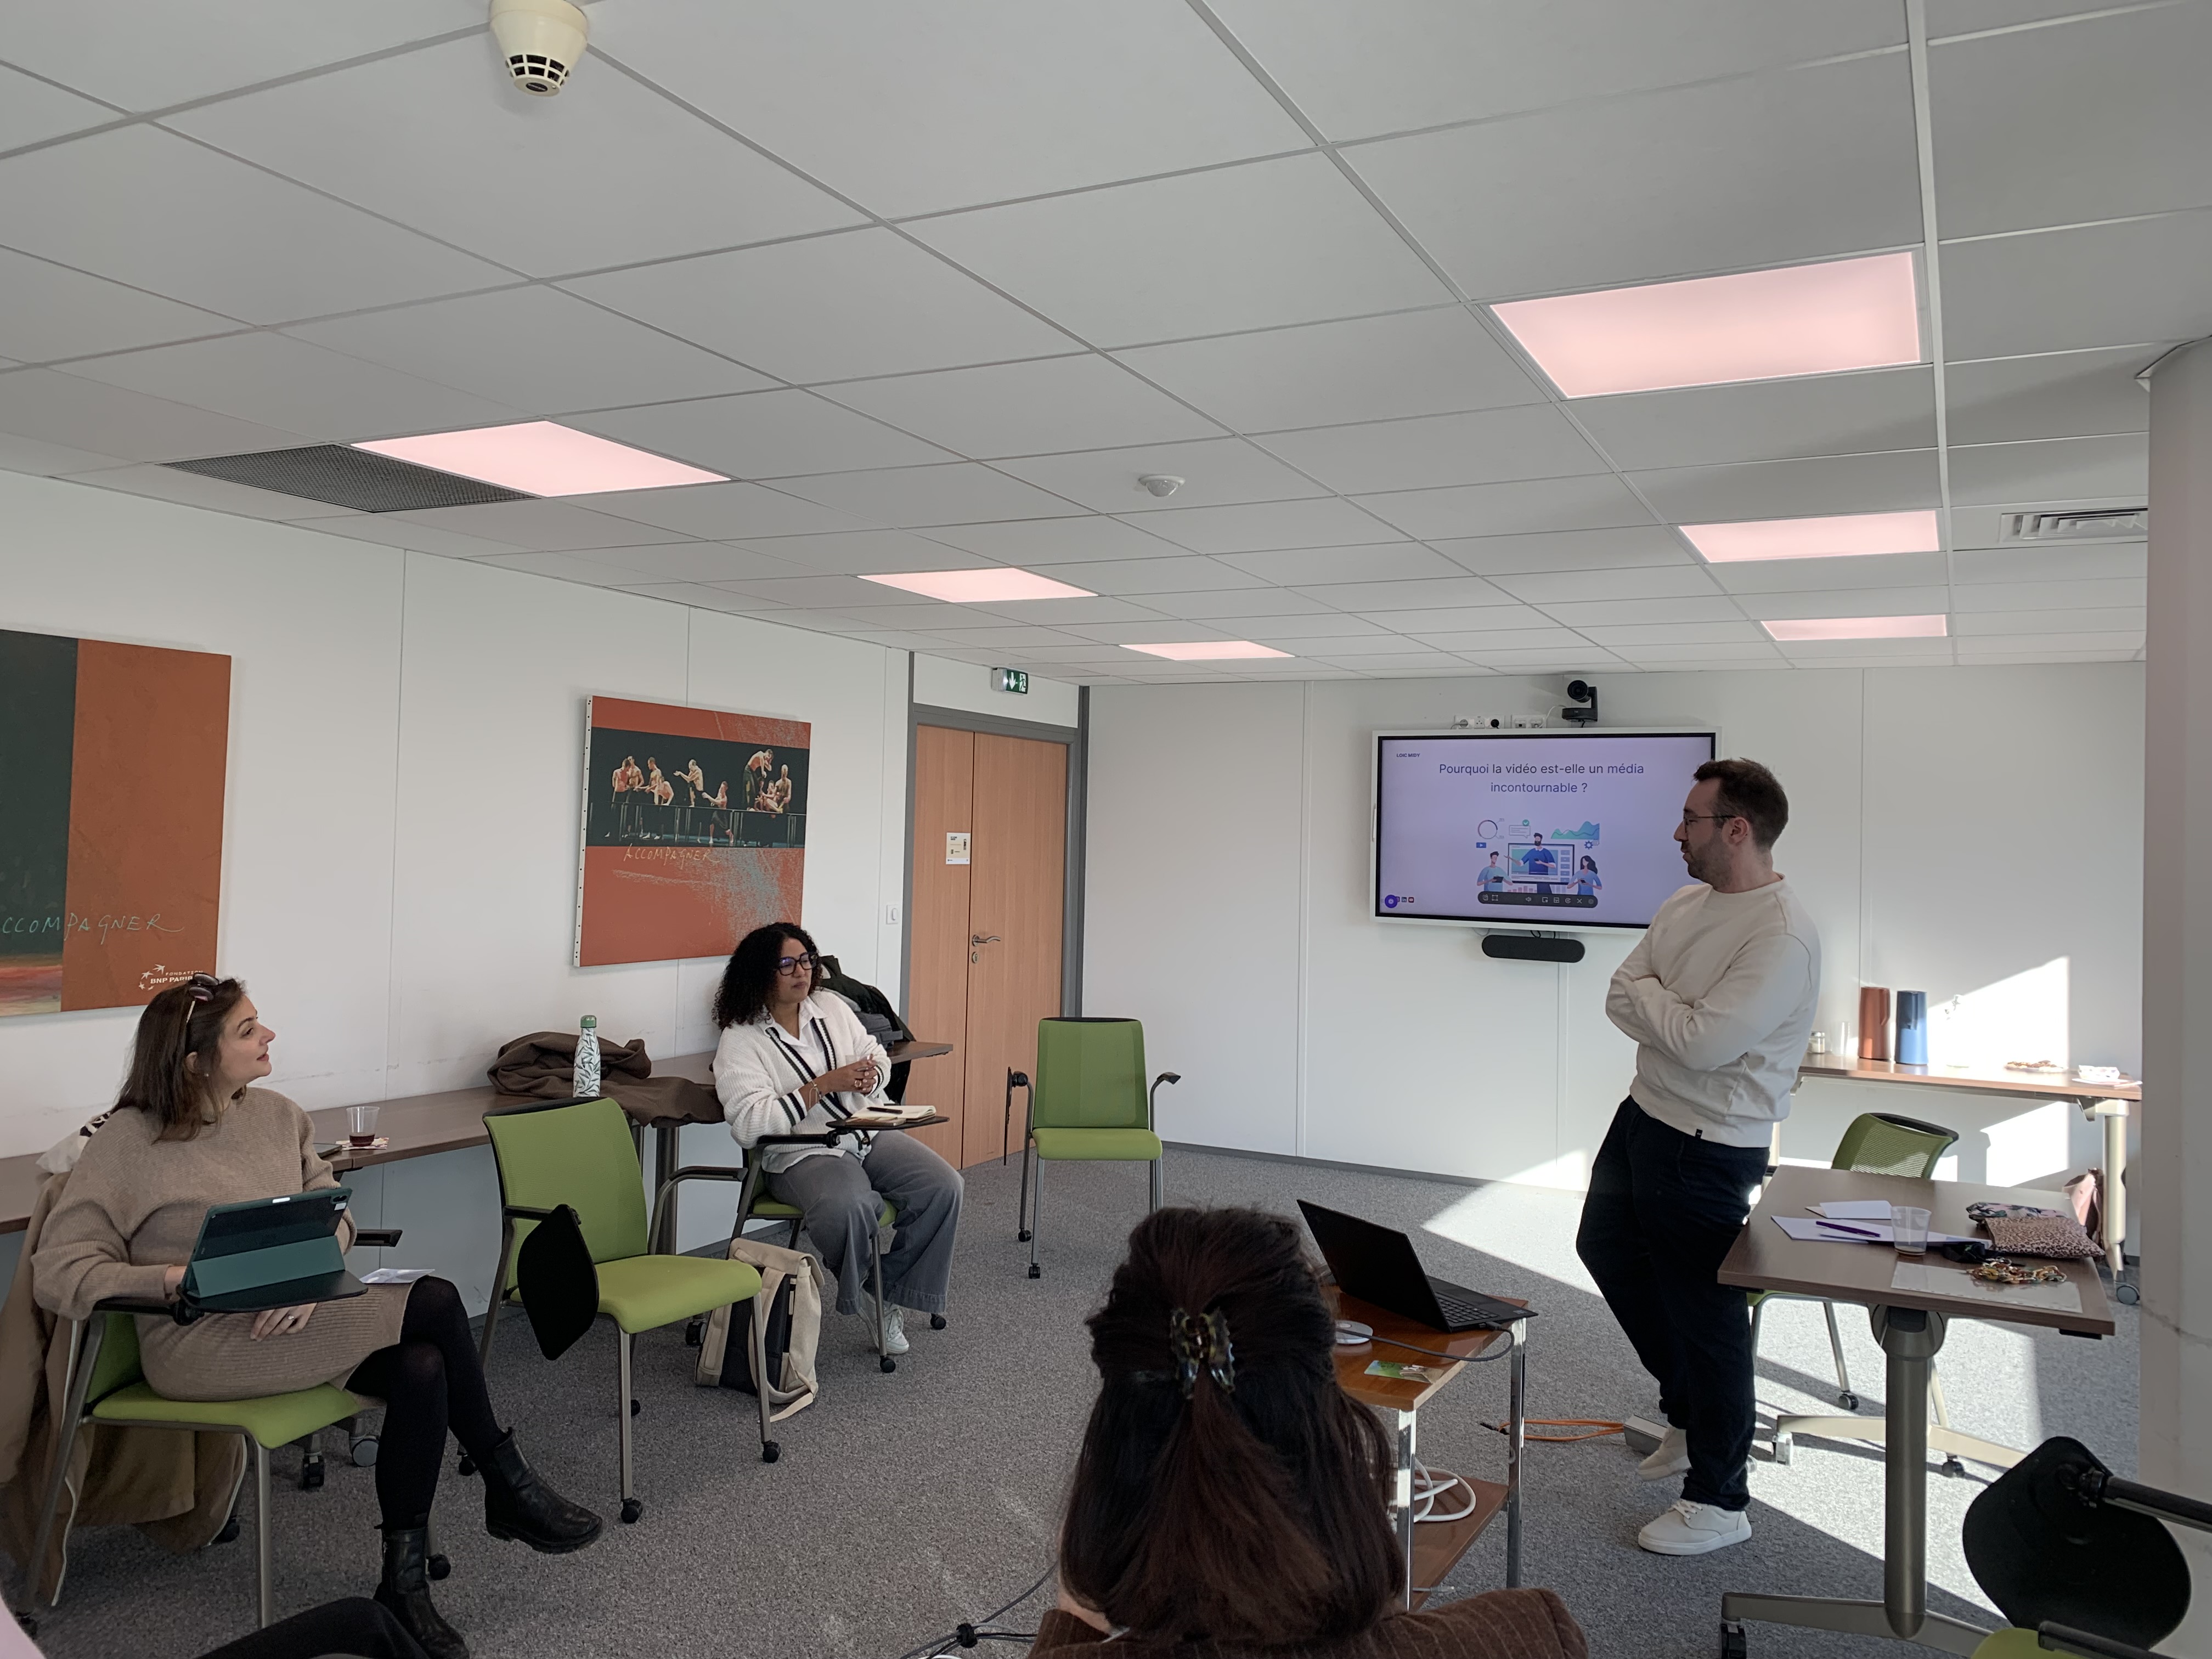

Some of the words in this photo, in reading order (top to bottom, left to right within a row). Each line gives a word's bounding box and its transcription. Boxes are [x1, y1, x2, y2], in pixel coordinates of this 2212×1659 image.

[1440, 764, 1489, 775] Pourquoi
[1492, 764, 1502, 774] la
[1505, 764, 1537, 774] vidéo
[1541, 764, 1585, 774] est-elle
[1607, 764, 1644, 774] média
[1491, 782, 1577, 793] incontournable
[1582, 783, 1588, 793] ?
[623, 843, 722, 870] ACCOMPAGNER
[2, 912, 185, 945] CCOMPAGNER
